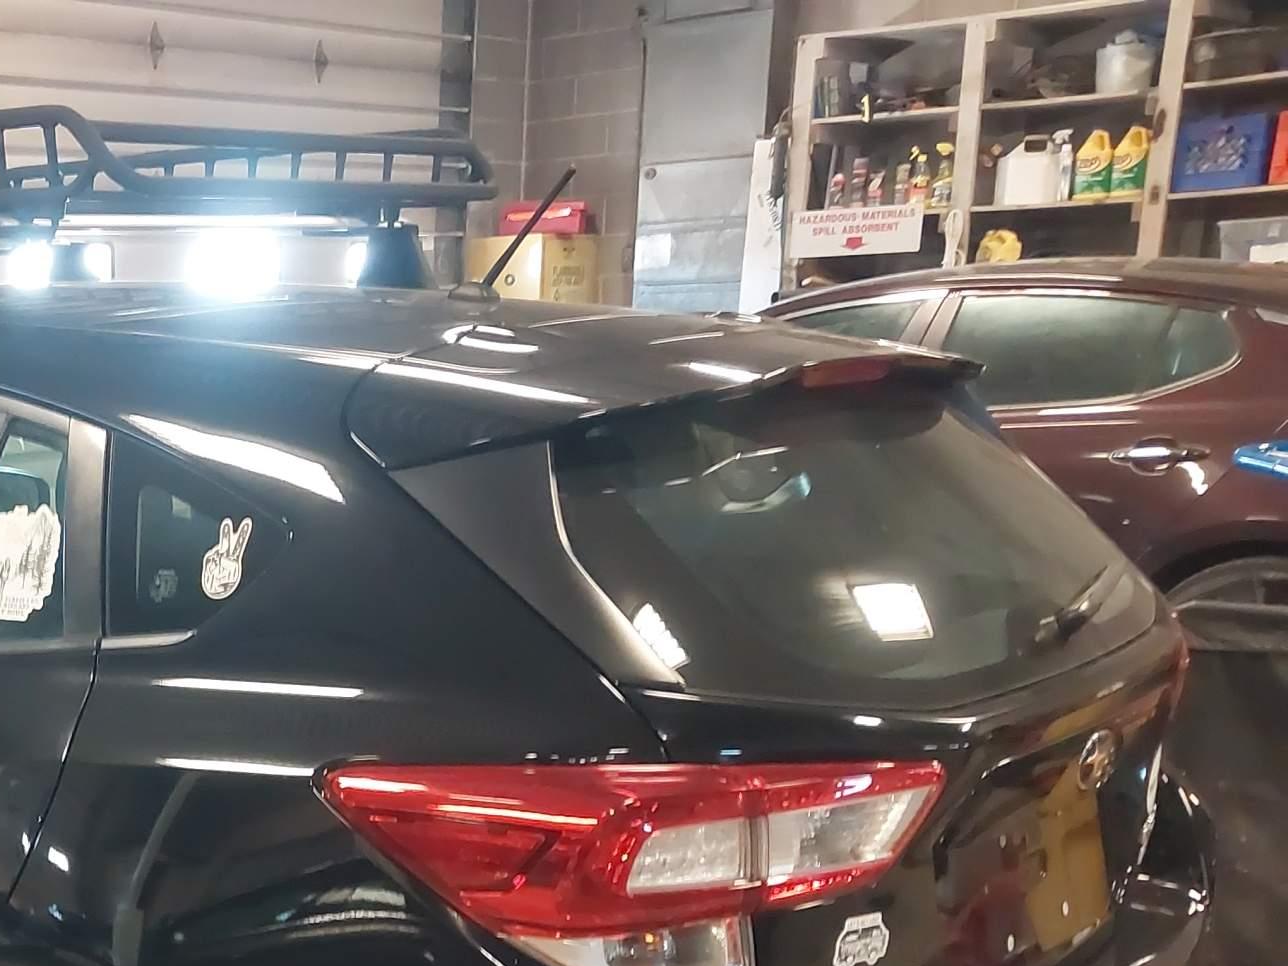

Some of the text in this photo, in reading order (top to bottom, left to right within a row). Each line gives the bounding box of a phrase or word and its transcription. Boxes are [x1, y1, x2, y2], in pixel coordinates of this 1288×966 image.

[799, 207, 916, 224] HAZARDOUS MATERIALS
[812, 222, 899, 236] SPILL ABSORBENT
